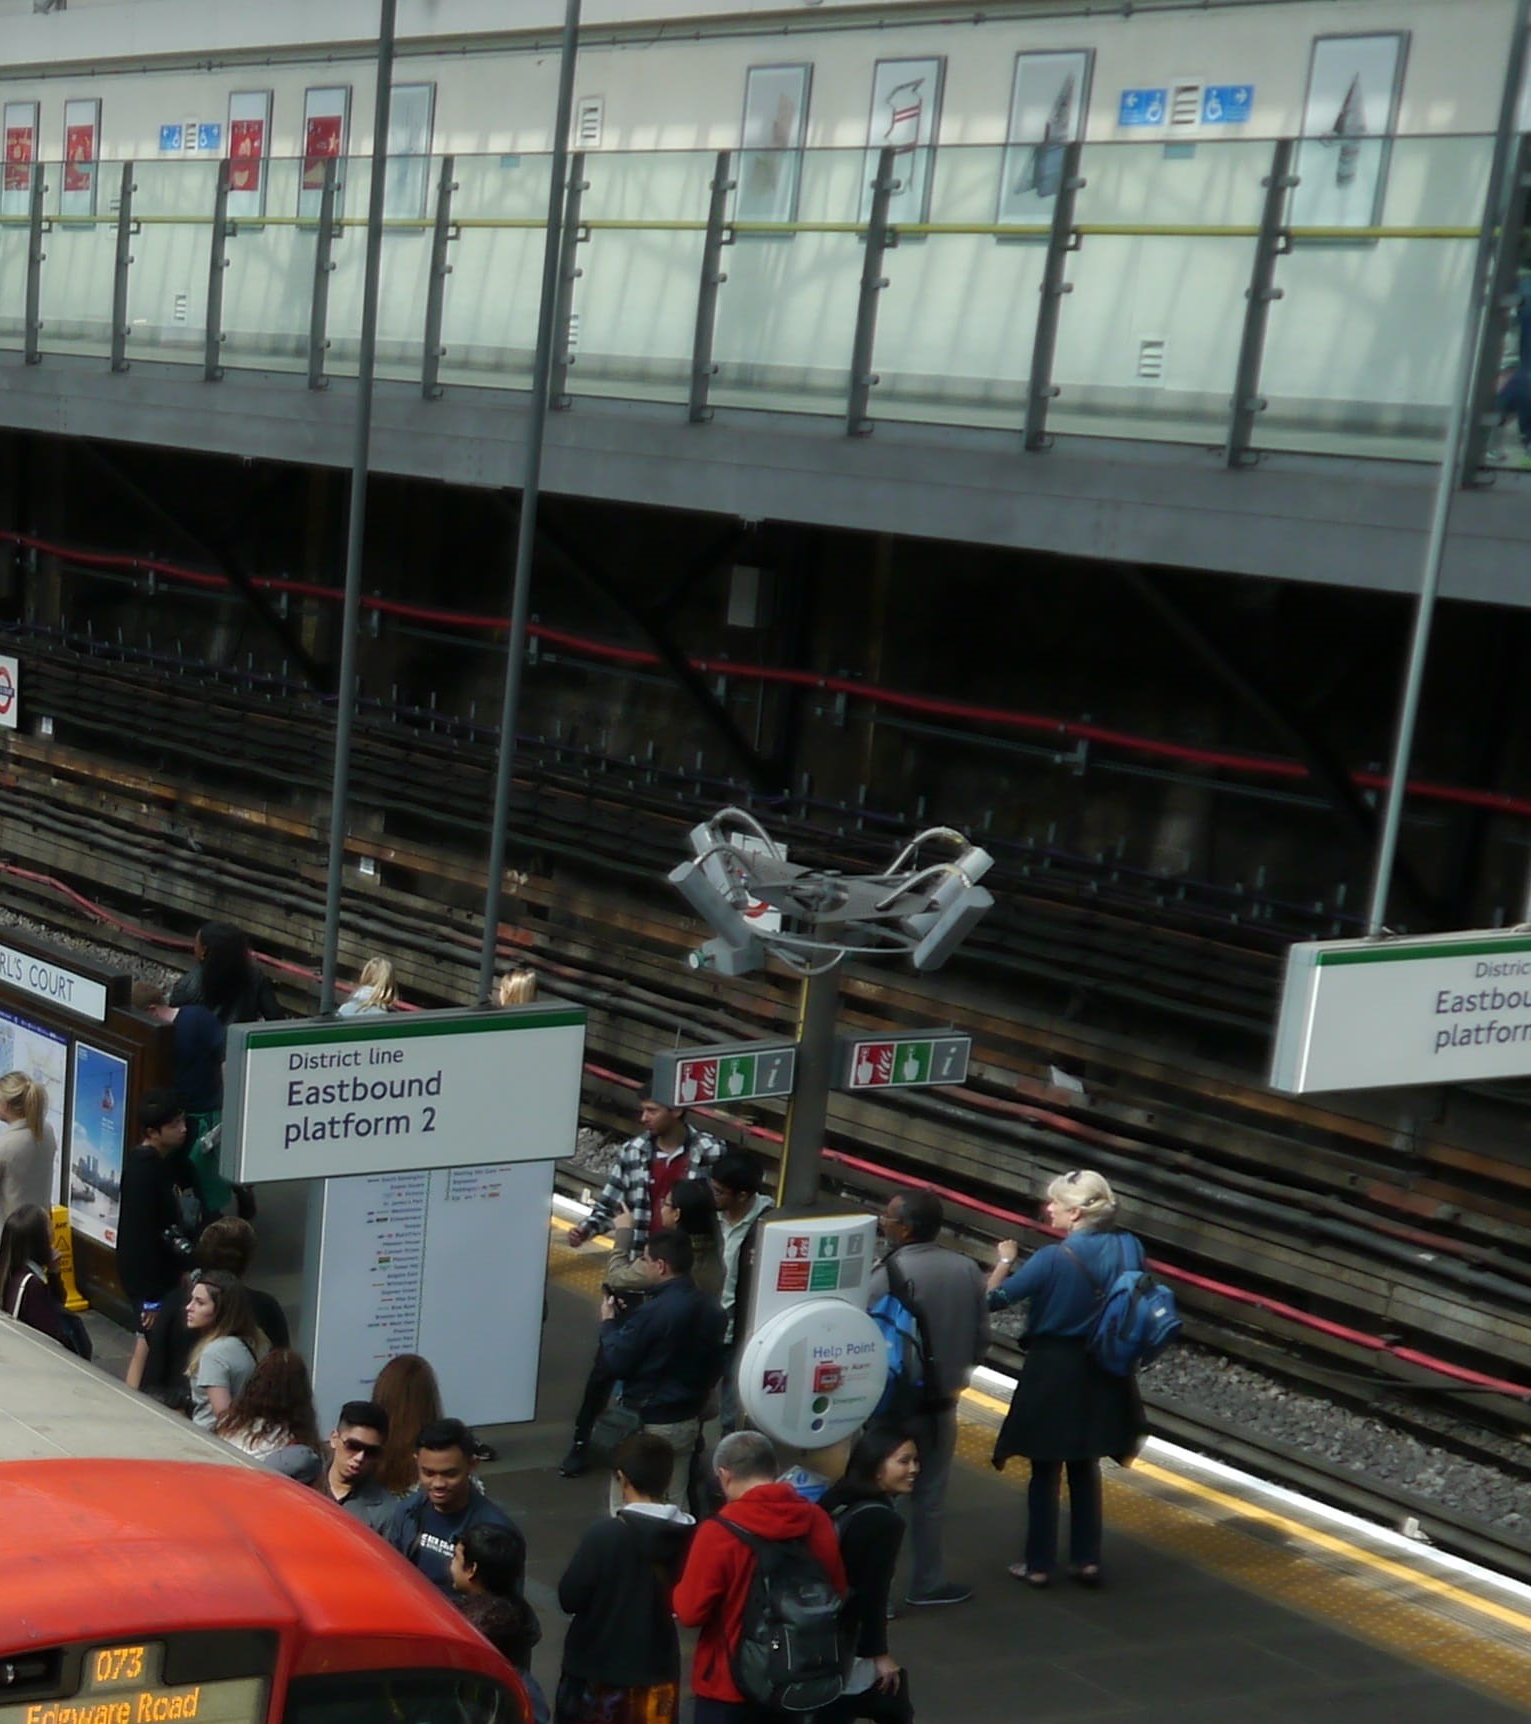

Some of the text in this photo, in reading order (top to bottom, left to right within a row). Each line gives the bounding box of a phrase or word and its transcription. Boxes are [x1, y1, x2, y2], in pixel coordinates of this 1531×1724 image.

[28, 964, 75, 1002] COURT
[289, 1047, 404, 1071] District line
[287, 1070, 443, 1107] Eastbound
[284, 1106, 437, 1150] platform 2
[813, 1341, 876, 1359] Help Point
[96, 1645, 145, 1682] 073
[136, 1686, 201, 1724] Road
